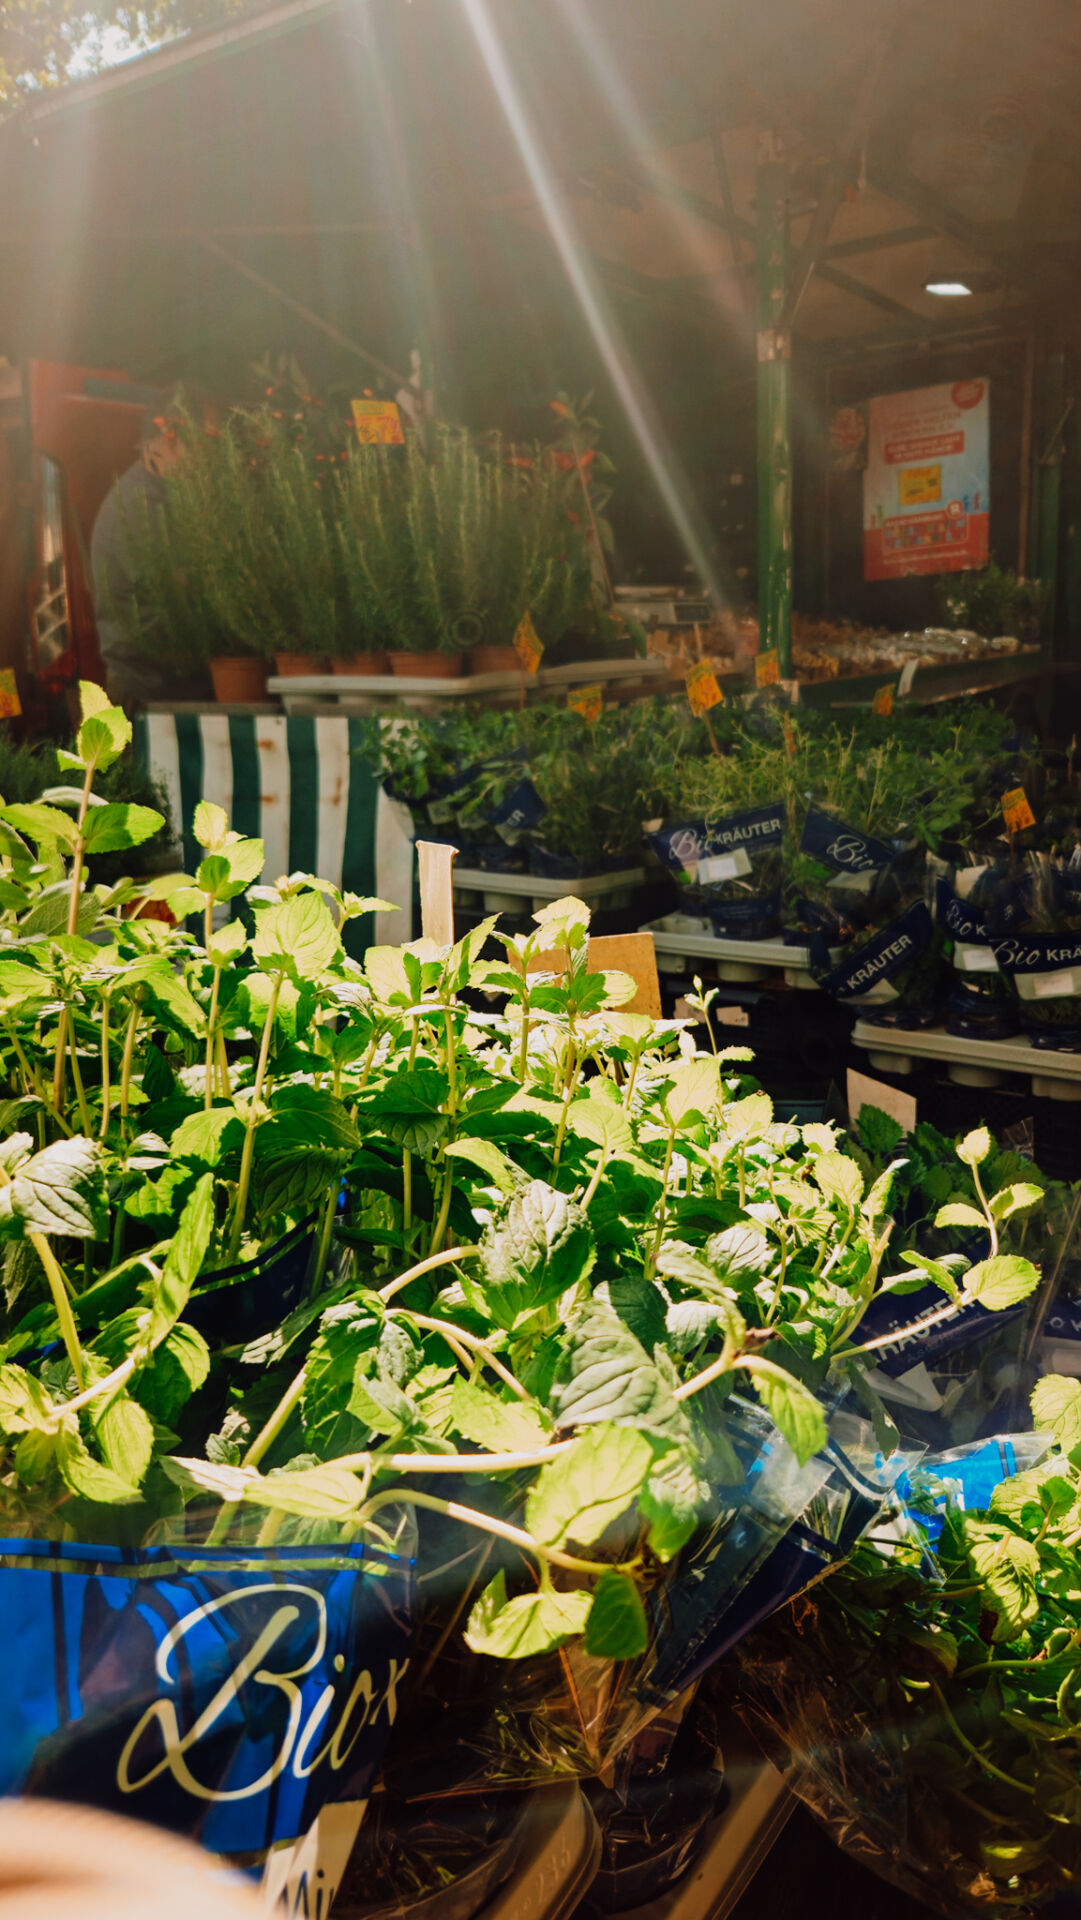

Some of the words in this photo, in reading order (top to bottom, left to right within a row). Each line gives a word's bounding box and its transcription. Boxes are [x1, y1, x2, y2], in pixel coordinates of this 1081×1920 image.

[715, 818, 781, 845] KRÄUTER
[826, 834, 874, 869] Bio
[846, 931, 912, 990] KRÄUTER
[988, 938, 1041, 967] Bio
[117, 1583, 377, 1802] Bio
